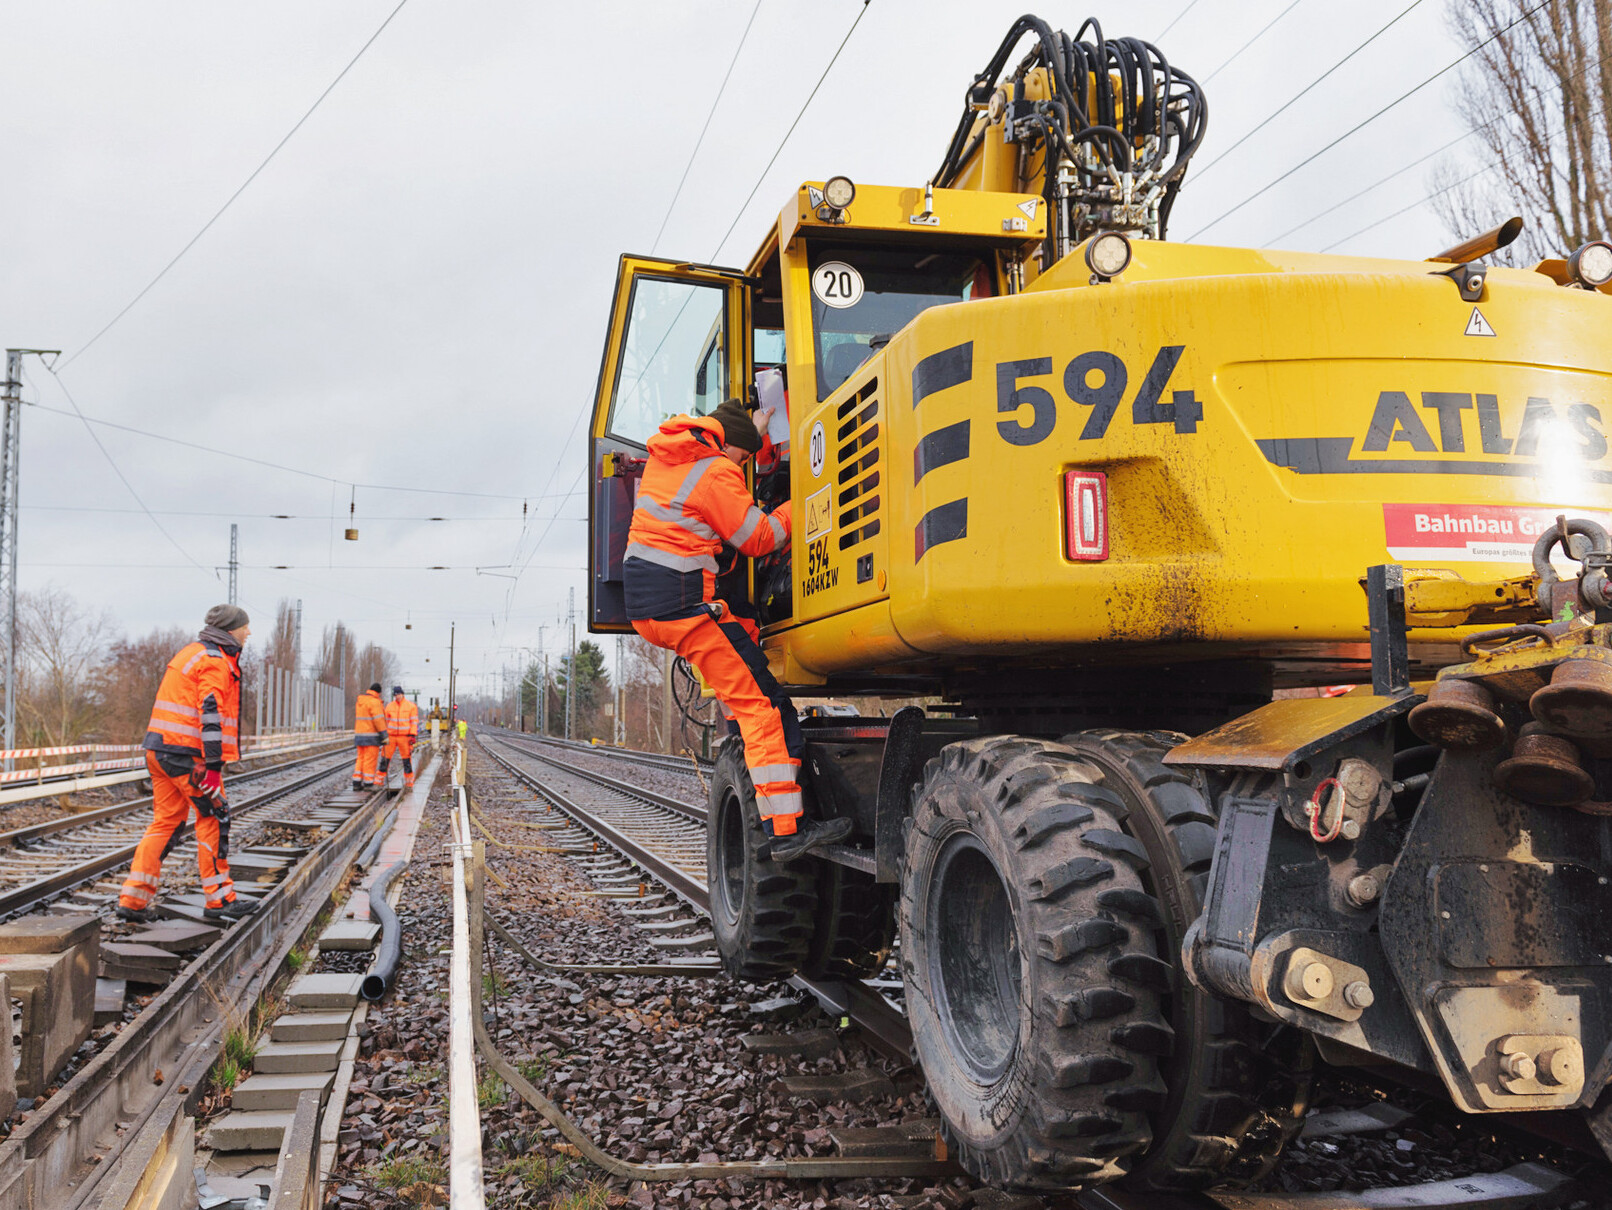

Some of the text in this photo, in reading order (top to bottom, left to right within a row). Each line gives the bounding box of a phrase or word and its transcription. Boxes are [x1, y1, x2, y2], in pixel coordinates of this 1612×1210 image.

[823, 271, 852, 298] 20
[996, 345, 1204, 446] 594
[1361, 391, 1608, 461] ATLAS
[811, 431, 823, 468] 20
[1414, 513, 1513, 535] Bahnbau
[808, 536, 829, 577] 594
[1472, 547, 1500, 556] Europas
[1502, 549, 1527, 557] größtes
[802, 567, 839, 598] 1604KZW
